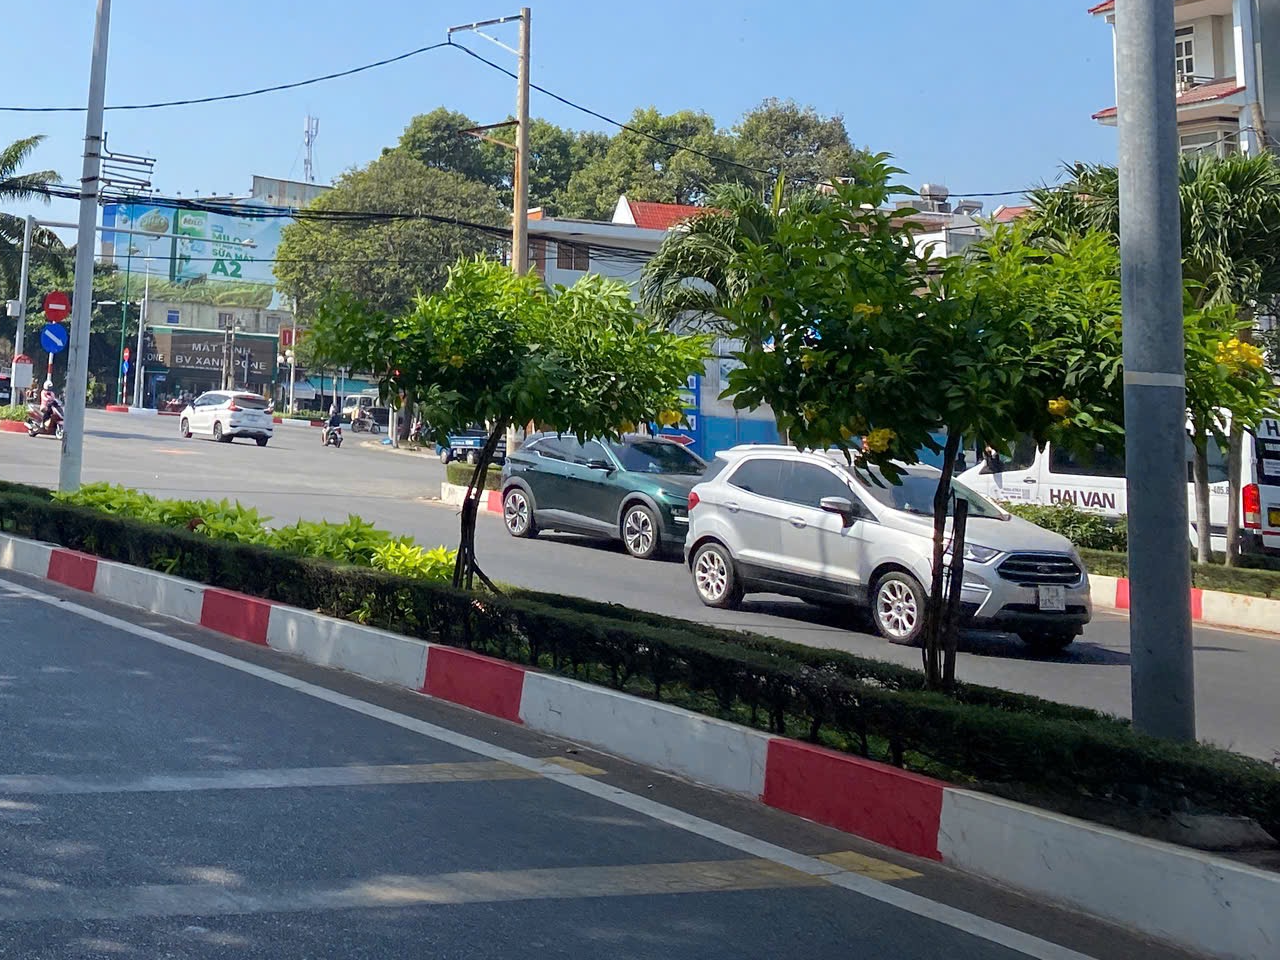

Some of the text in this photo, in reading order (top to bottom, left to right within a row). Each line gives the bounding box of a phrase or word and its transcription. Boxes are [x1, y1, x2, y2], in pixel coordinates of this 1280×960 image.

[211, 259, 242, 279] A2
[175, 355, 192, 364] BV
[1079, 490, 1116, 509] VAN
